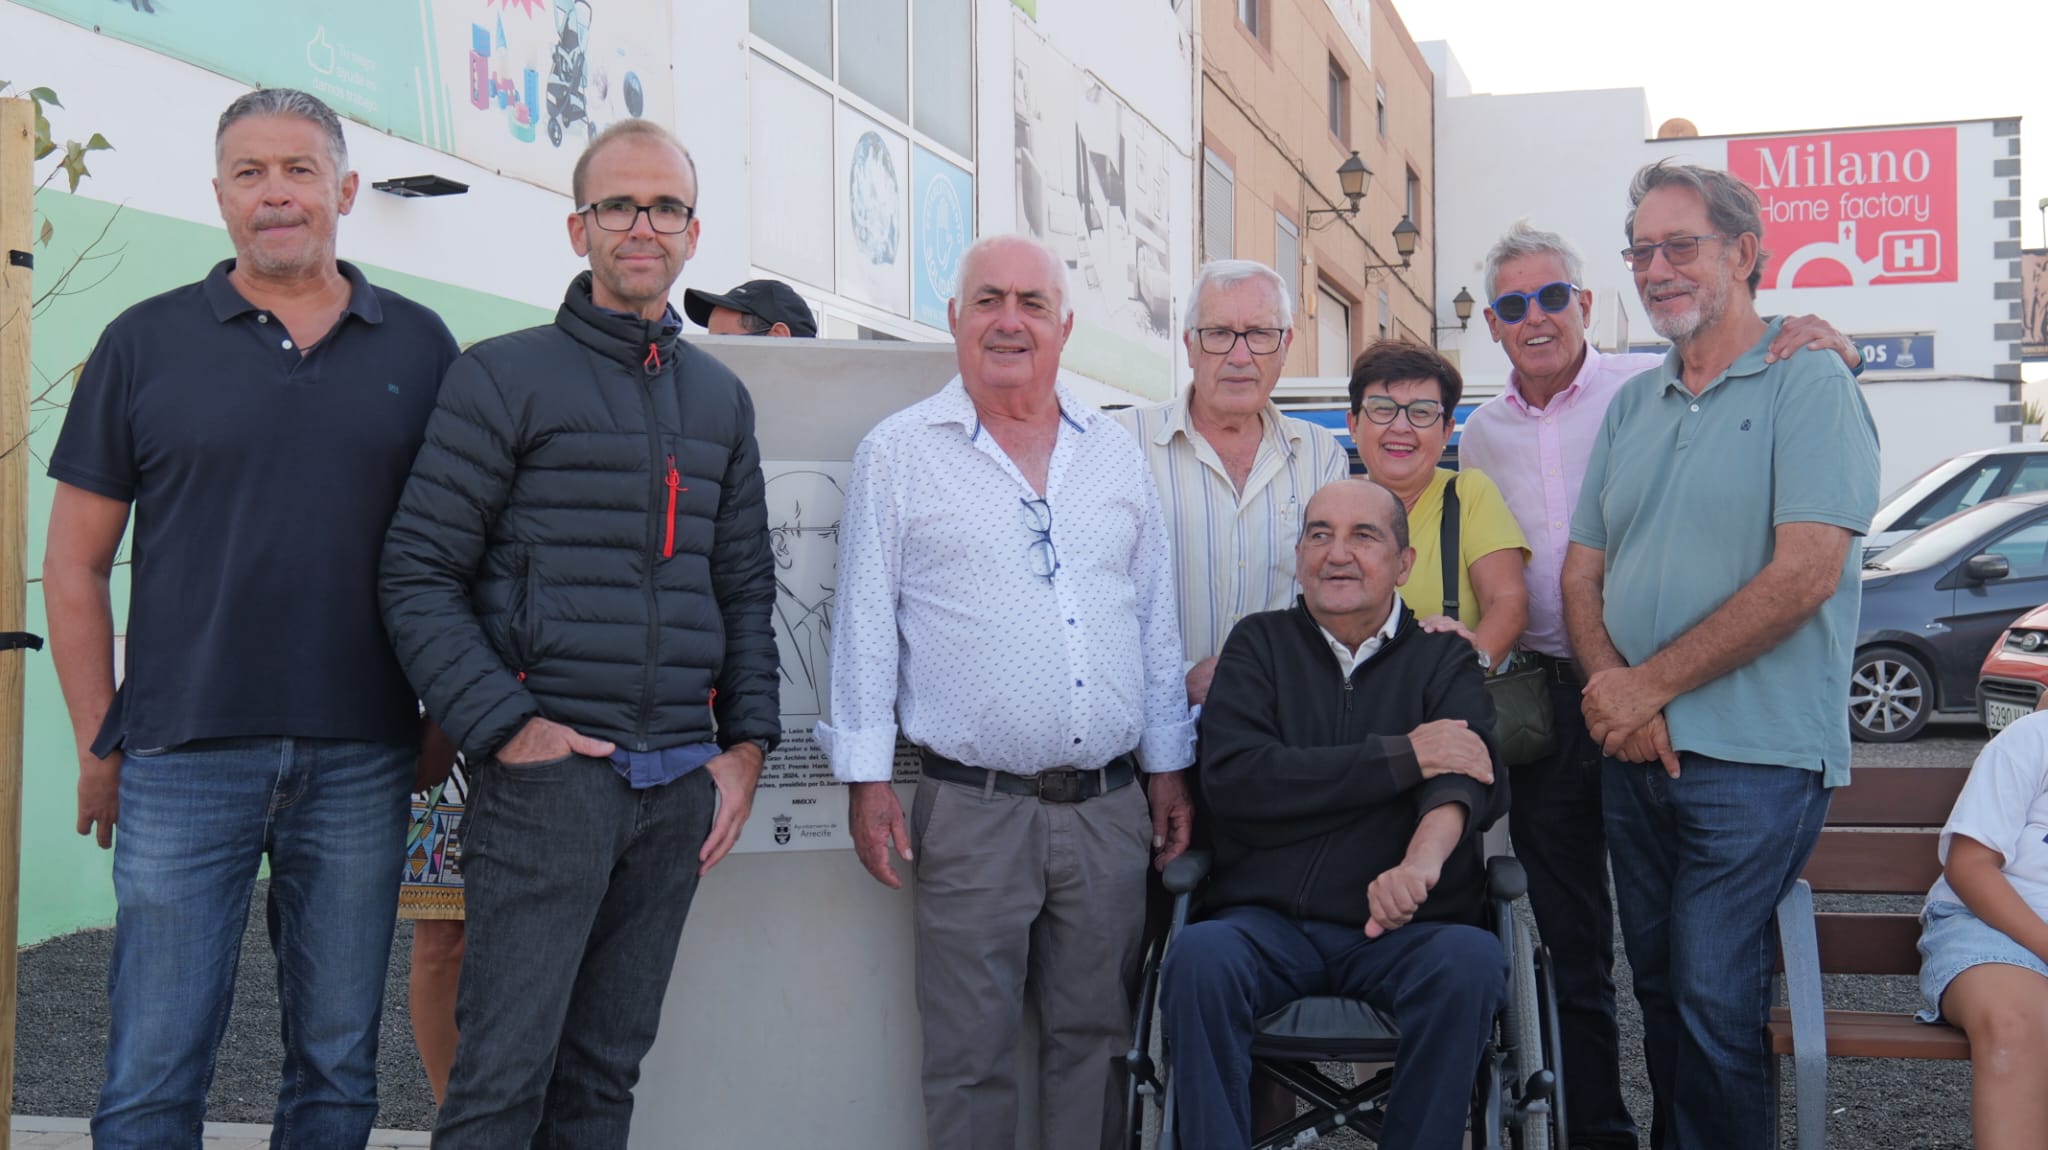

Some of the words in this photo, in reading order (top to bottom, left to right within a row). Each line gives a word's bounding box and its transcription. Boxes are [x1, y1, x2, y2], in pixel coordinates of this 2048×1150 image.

[1754, 141, 1931, 190] Milano
[1759, 195, 1830, 223] Home
[1839, 192, 1931, 222] factory
[1862, 344, 1888, 363] OS
[1990, 704, 2012, 726] 5290
[800, 830, 832, 838] Arrecife
